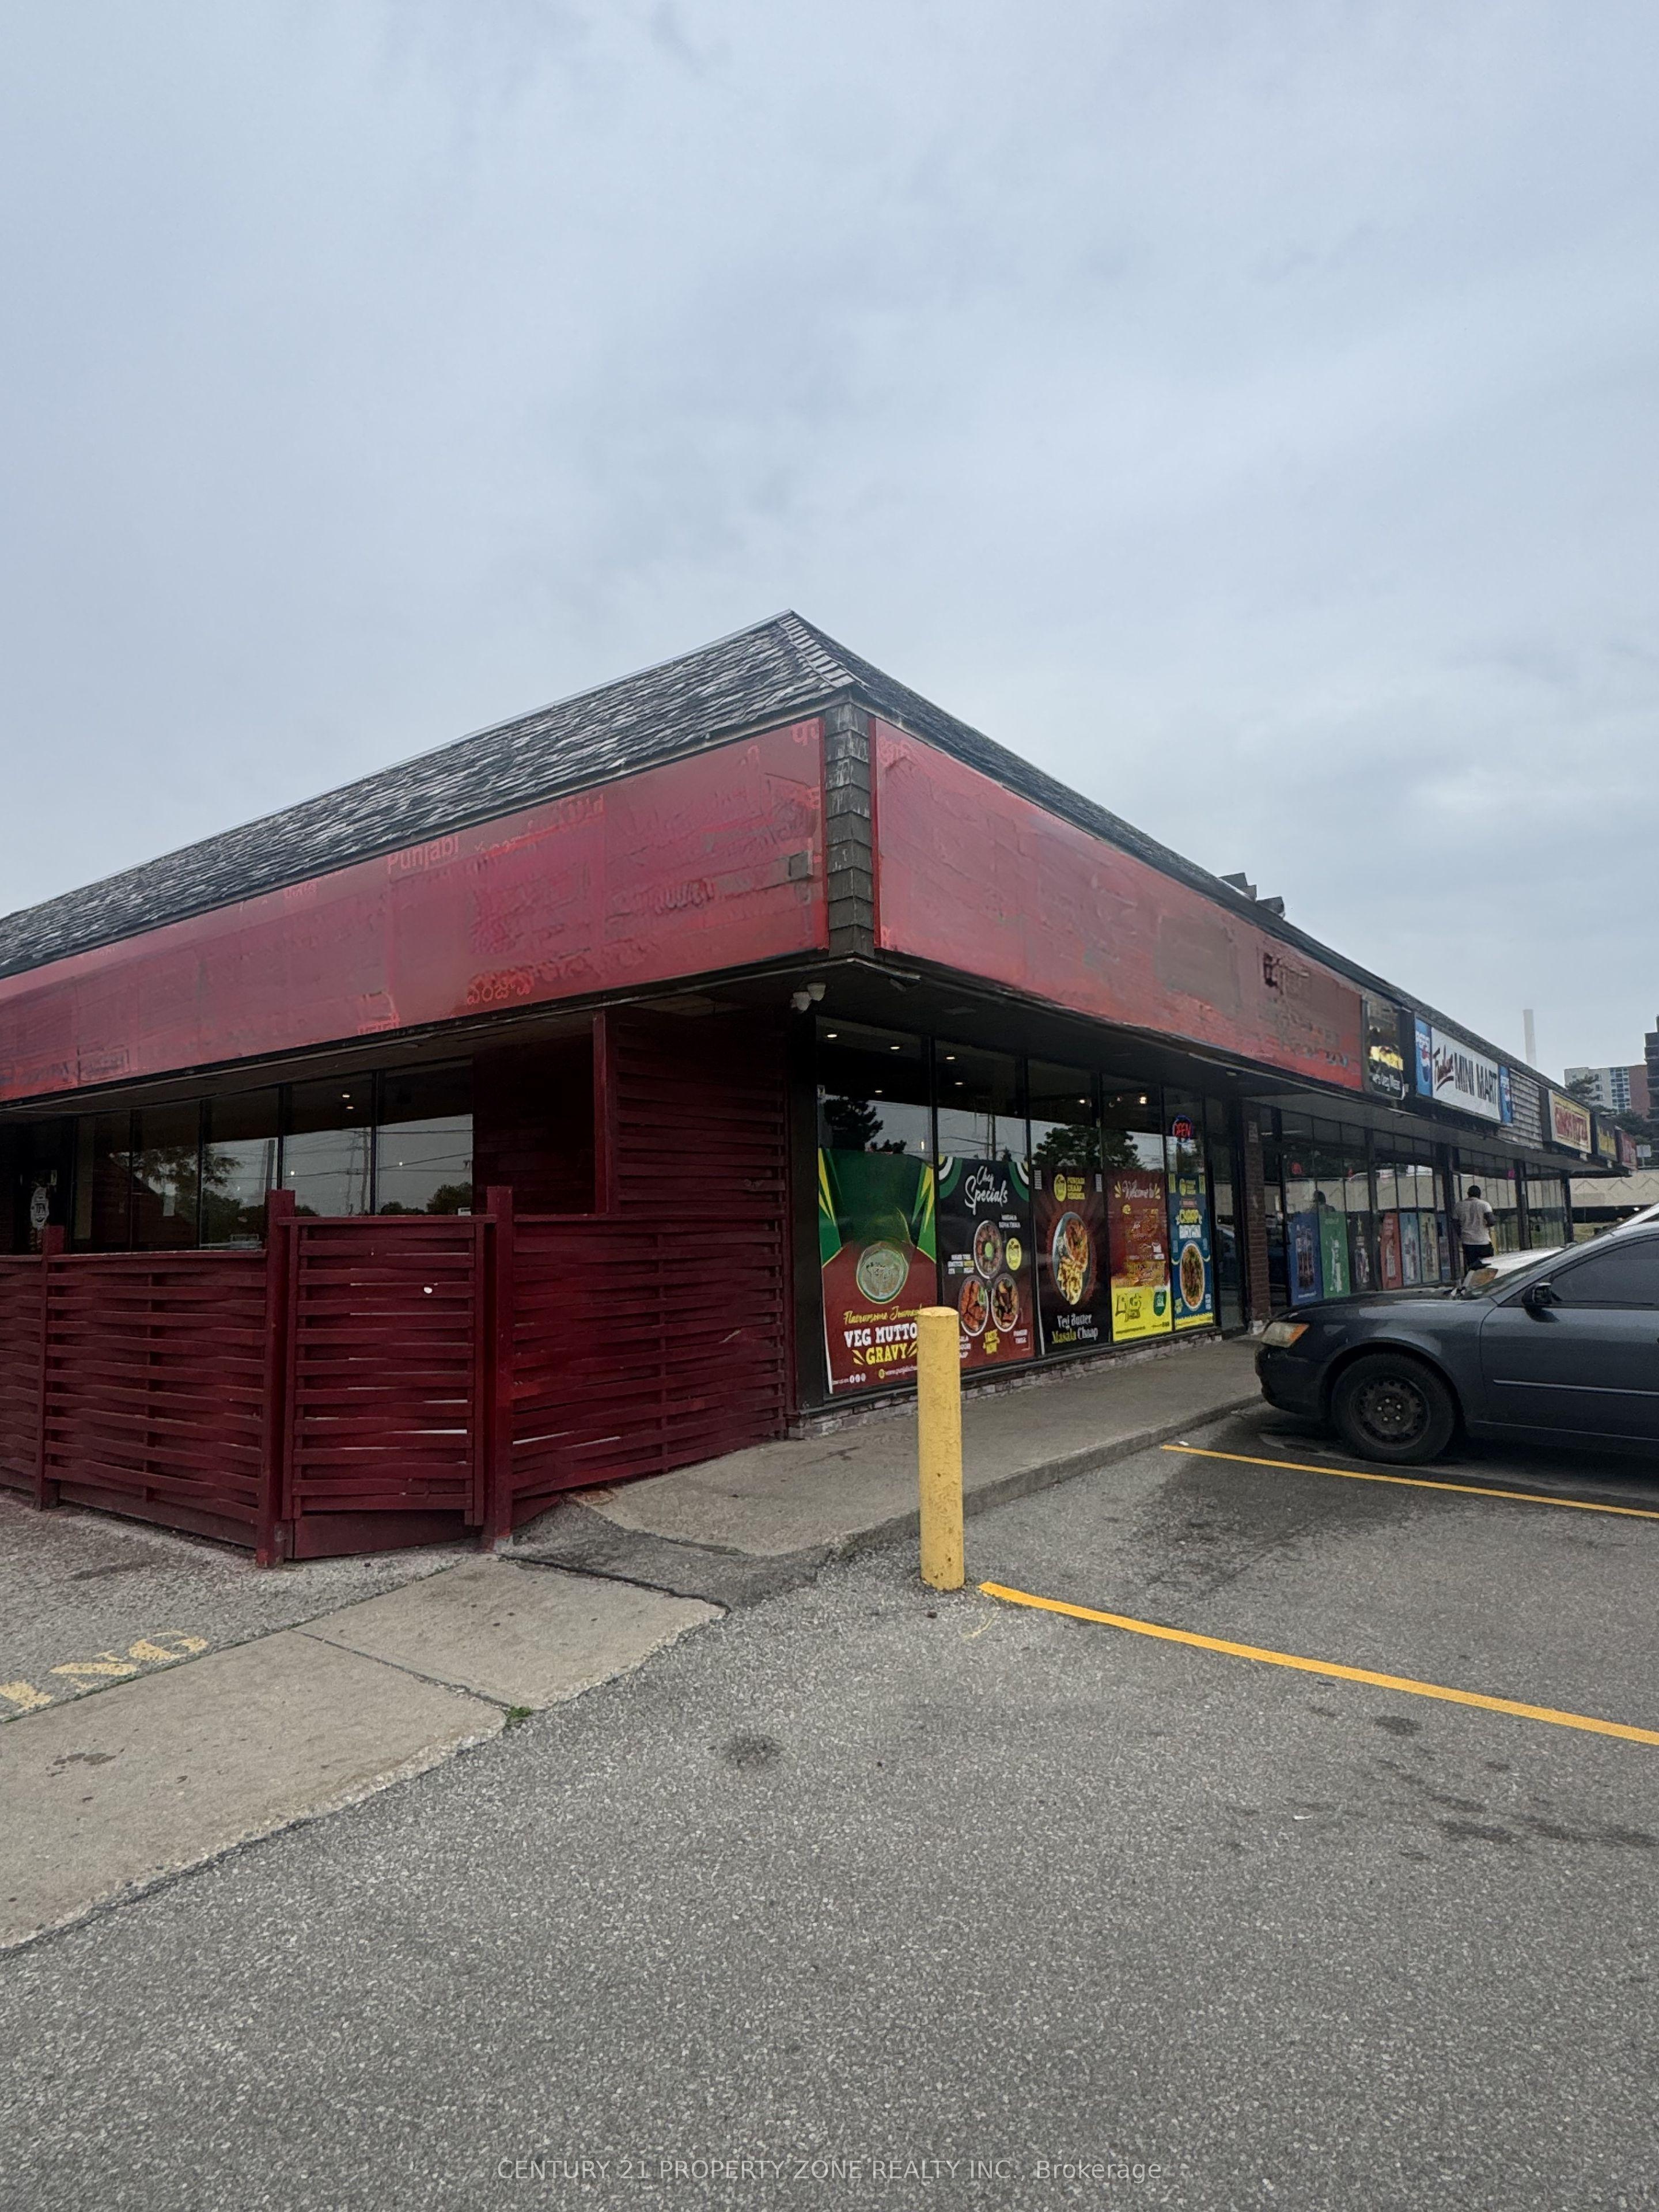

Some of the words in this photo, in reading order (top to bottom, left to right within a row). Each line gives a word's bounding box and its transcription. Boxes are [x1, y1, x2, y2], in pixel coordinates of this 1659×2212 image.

[1454, 1052, 1475, 1096] MINI
[1476, 1063, 1497, 1104] MART
[964, 1175, 1008, 1216] Specials
[844, 1328, 871, 1348] VEG
[874, 1323, 918, 1343] MUTTO
[1052, 1328, 1077, 1344] Masala
[866, 1343, 907, 1365] GRAVY
